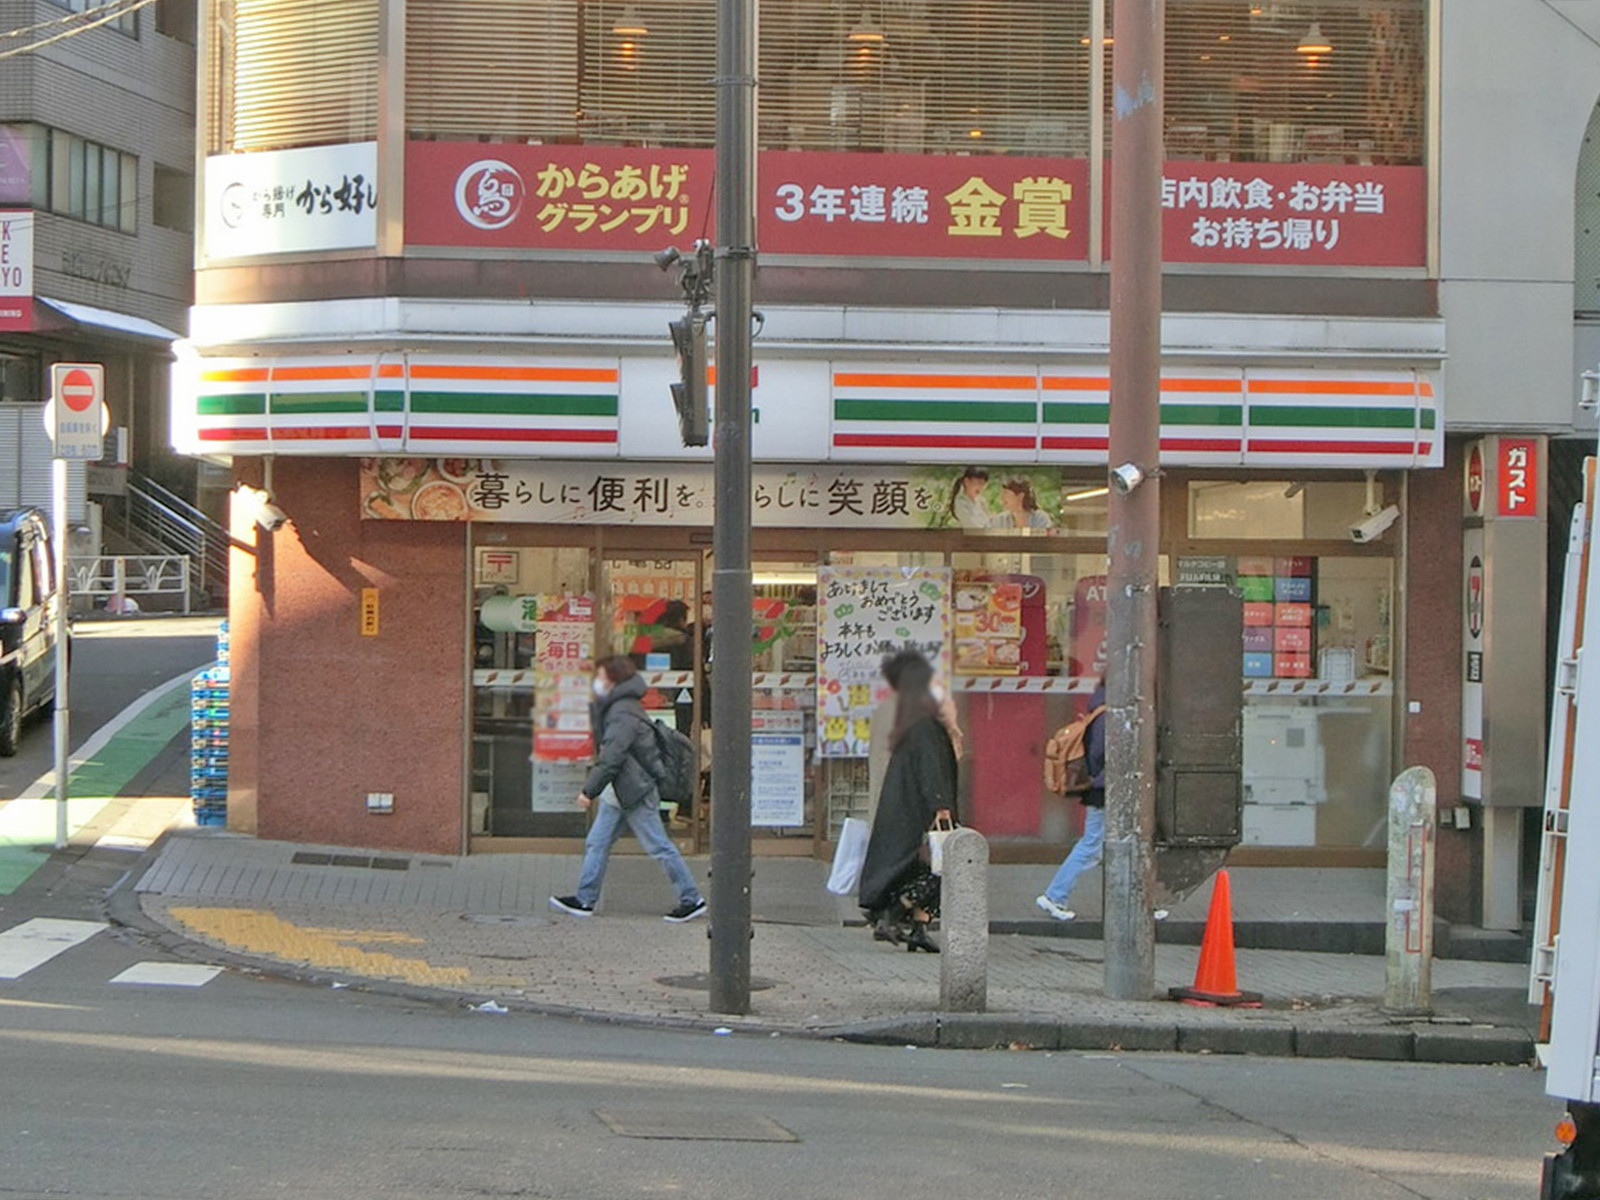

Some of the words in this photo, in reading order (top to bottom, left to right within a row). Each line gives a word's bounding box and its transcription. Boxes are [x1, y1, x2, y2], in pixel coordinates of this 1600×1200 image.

[536, 162, 689, 201] からあげ
[536, 203, 689, 235] グランプリ
[775, 184, 929, 224] 3年連続
[945, 176, 1072, 239] 金賞
[1190, 216, 1340, 251] お持ち帰り
[1507, 446, 1527, 509] ガスト
[753, 478, 942, 516] らしに笑顔を。
[1086, 586, 1108, 601] AT
[838, 621, 876, 639] 本年も
[547, 641, 580, 659] 毎日
